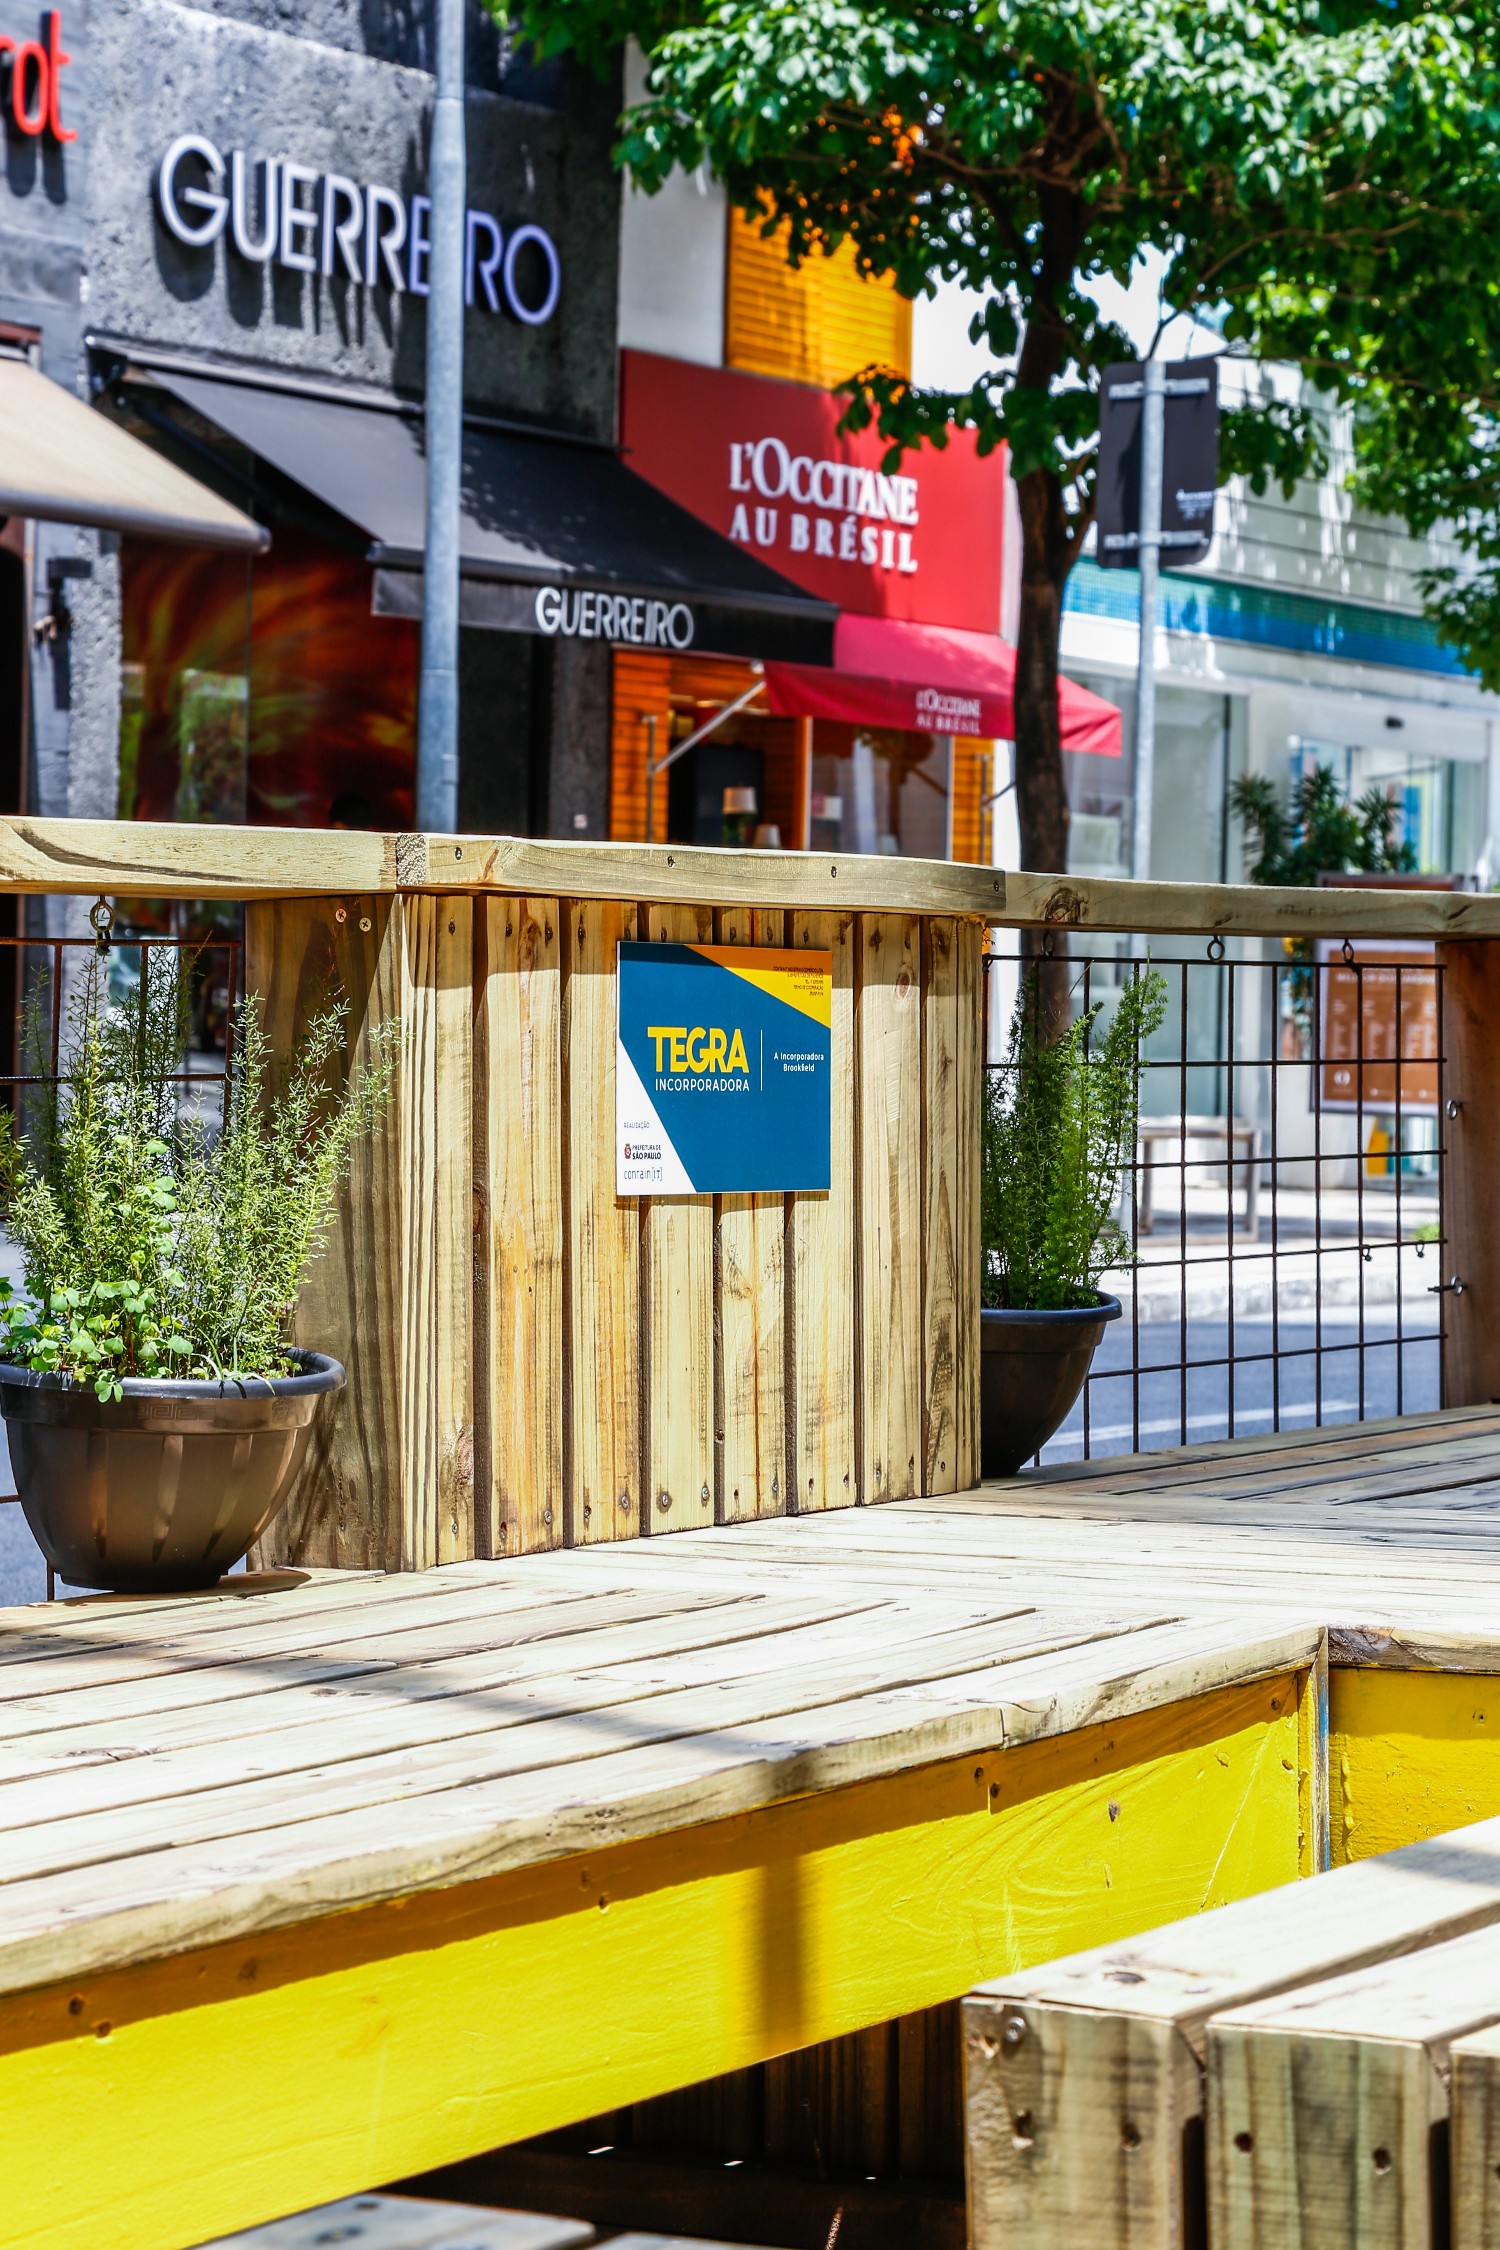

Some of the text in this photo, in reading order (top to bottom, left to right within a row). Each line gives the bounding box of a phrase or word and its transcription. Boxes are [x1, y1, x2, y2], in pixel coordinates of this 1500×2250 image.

[159, 134, 561, 325] GUERRERO
[729, 437, 920, 524] L'OCCITANE
[729, 503, 918, 573] AU BRÉSIL
[535, 586, 694, 649] GUERREIRO
[647, 1026, 750, 1074] TEGRA
[773, 1051, 825, 1062] A Incorporadora
[783, 1063, 815, 1072] Brookfield
[655, 1078, 750, 1092] INCORPORADORA
[632, 1151, 662, 1160] SÃO PAULO
